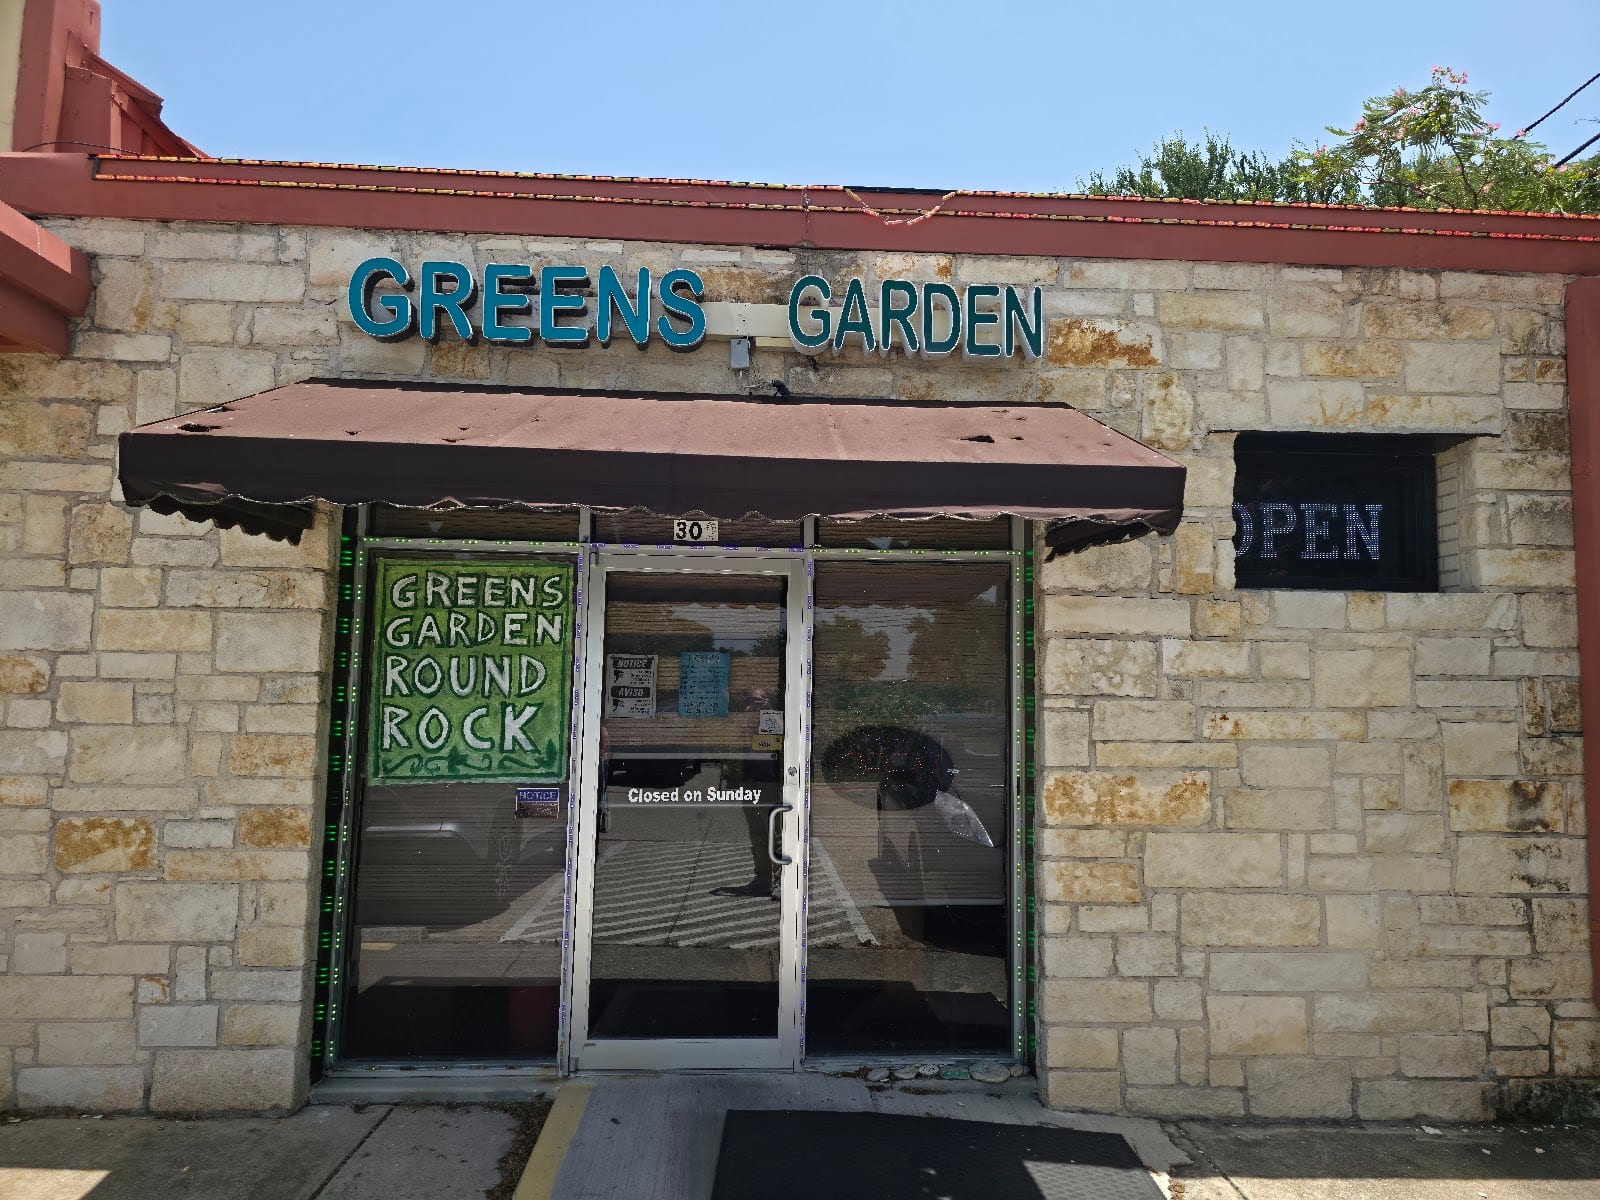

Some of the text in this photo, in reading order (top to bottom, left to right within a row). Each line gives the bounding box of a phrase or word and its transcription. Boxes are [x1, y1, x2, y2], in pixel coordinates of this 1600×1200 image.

[349, 256, 1043, 358] GREENS GARDEN
[676, 521, 717, 540] 30
[391, 570, 564, 609] GREENS
[385, 612, 563, 648] GARDEN
[384, 654, 547, 698] ROUND
[616, 659, 648, 668] NOTICE
[618, 687, 644, 697] AVISO
[382, 702, 541, 751] ROCK
[519, 791, 557, 800] NOTICE
[627, 786, 762, 805] Closed on Sunday
